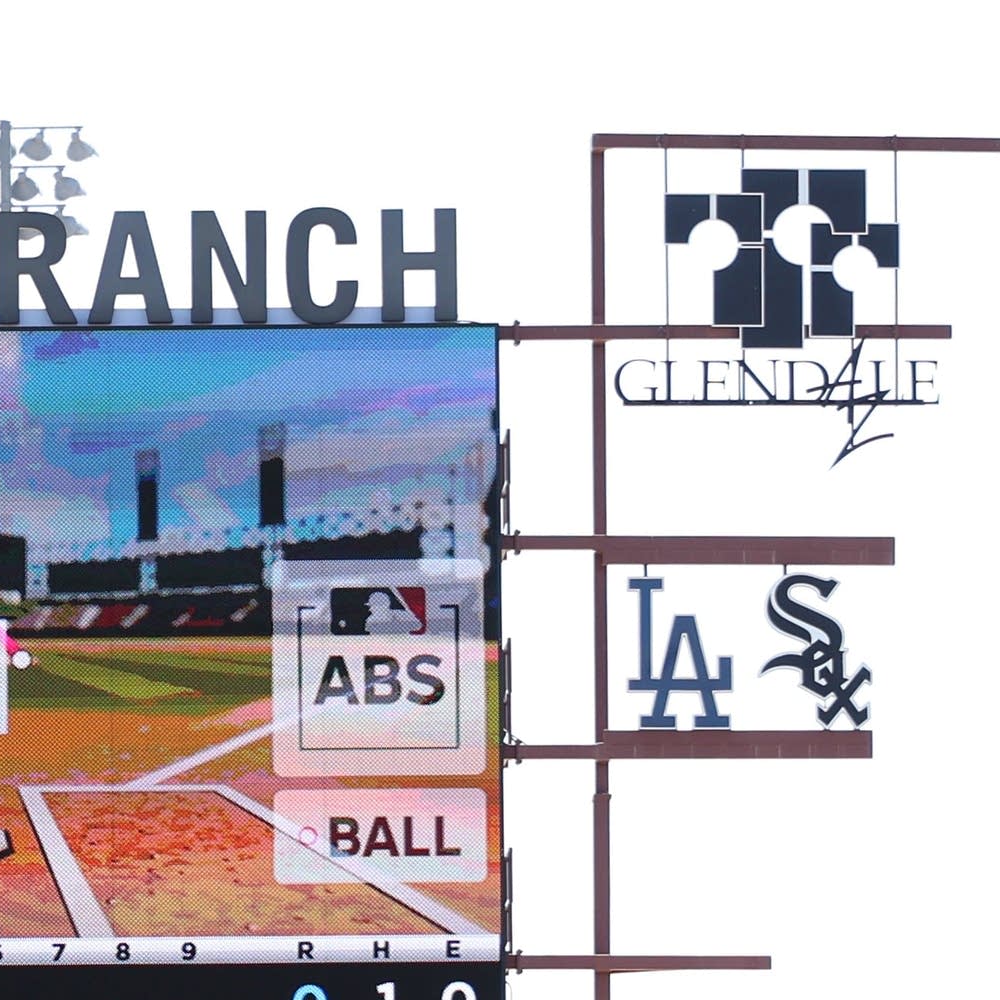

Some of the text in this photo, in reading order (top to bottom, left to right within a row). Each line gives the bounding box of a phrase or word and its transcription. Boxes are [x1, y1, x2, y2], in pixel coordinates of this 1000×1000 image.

[614, 338, 939, 405] GLENDALE
[627, 576, 733, 730] LA
[314, 654, 446, 705] ABS
[329, 815, 462, 857] BALL
[52, 943, 66, 961] 7
[116, 943, 131, 961] 8
[182, 943, 197, 961] 9
[298, 941, 314, 959] R
[374, 941, 389, 959] H
[446, 940, 460, 958] E
